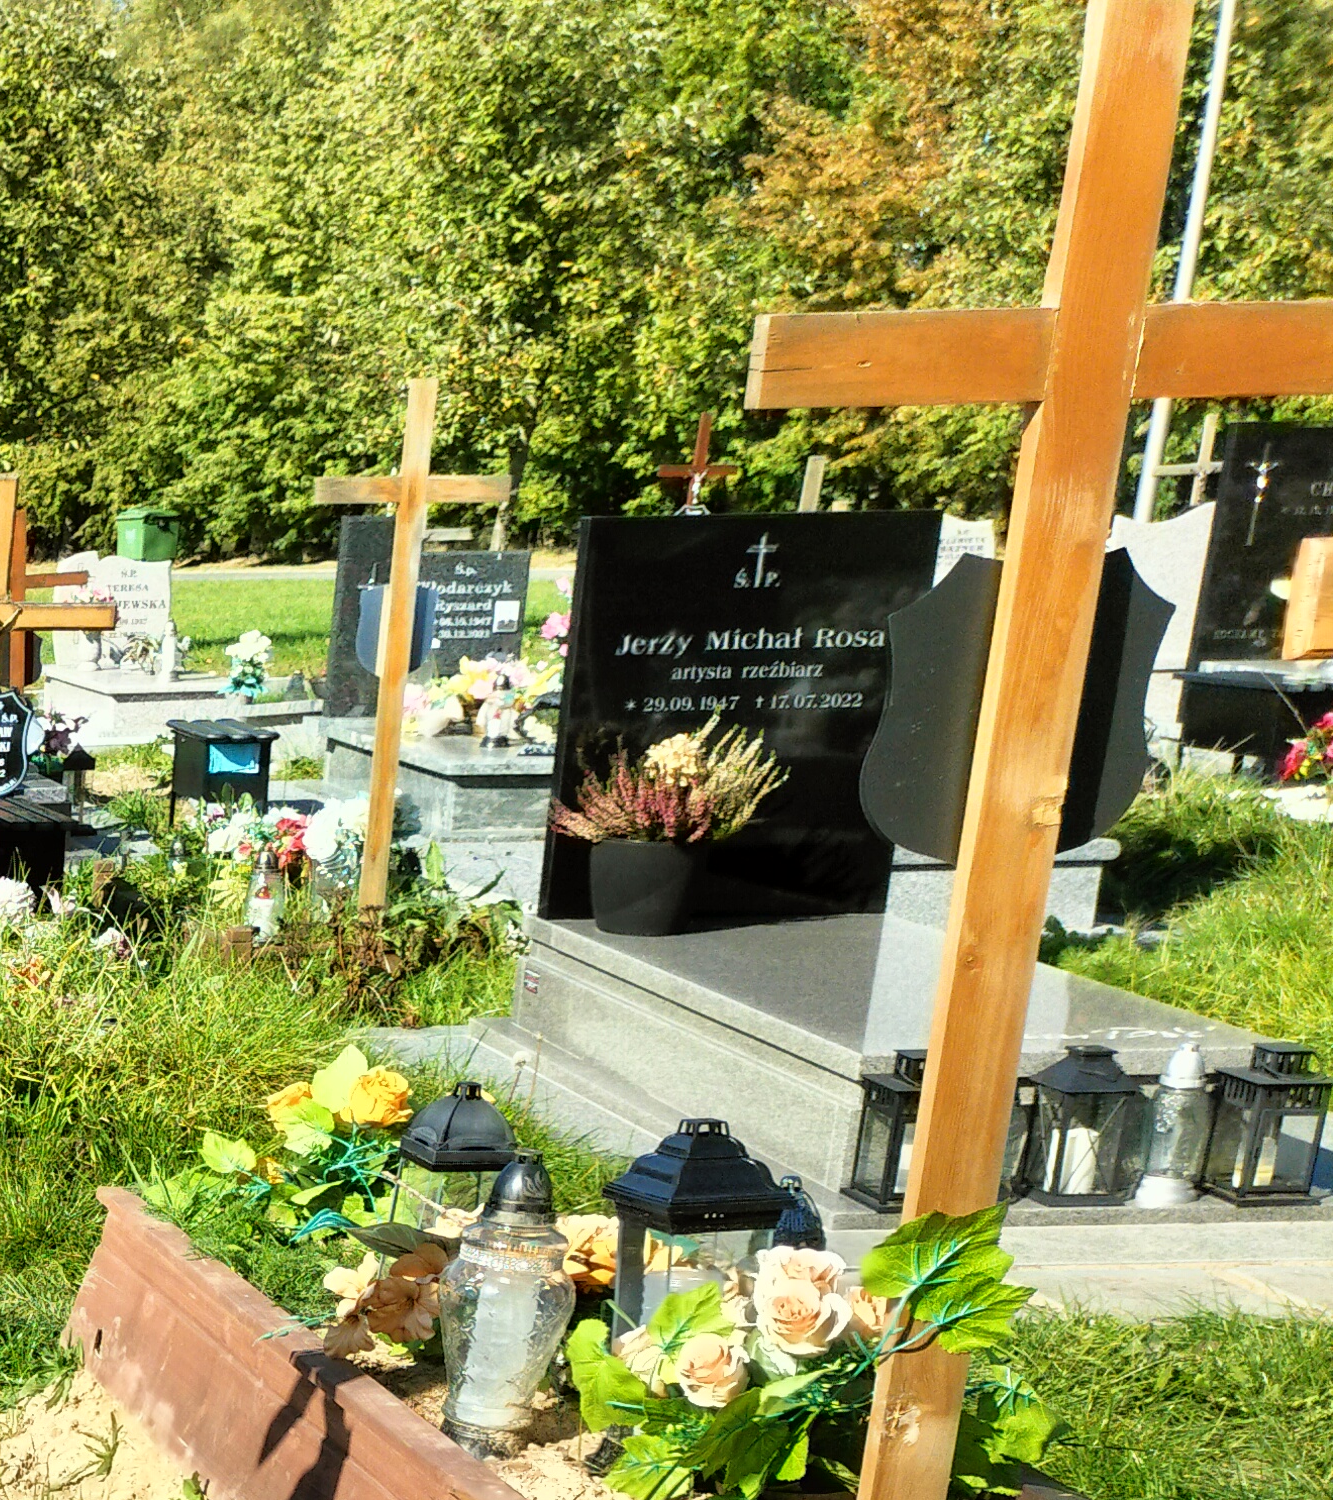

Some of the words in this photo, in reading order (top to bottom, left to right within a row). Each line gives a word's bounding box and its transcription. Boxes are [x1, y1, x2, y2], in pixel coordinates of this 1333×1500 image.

[615, 634, 693, 659] Jerzy
[704, 626, 804, 651] Michał
[813, 628, 886, 649] Rosa
[671, 664, 732, 683] artysta
[741, 660, 824, 679] rzeźbiarz
